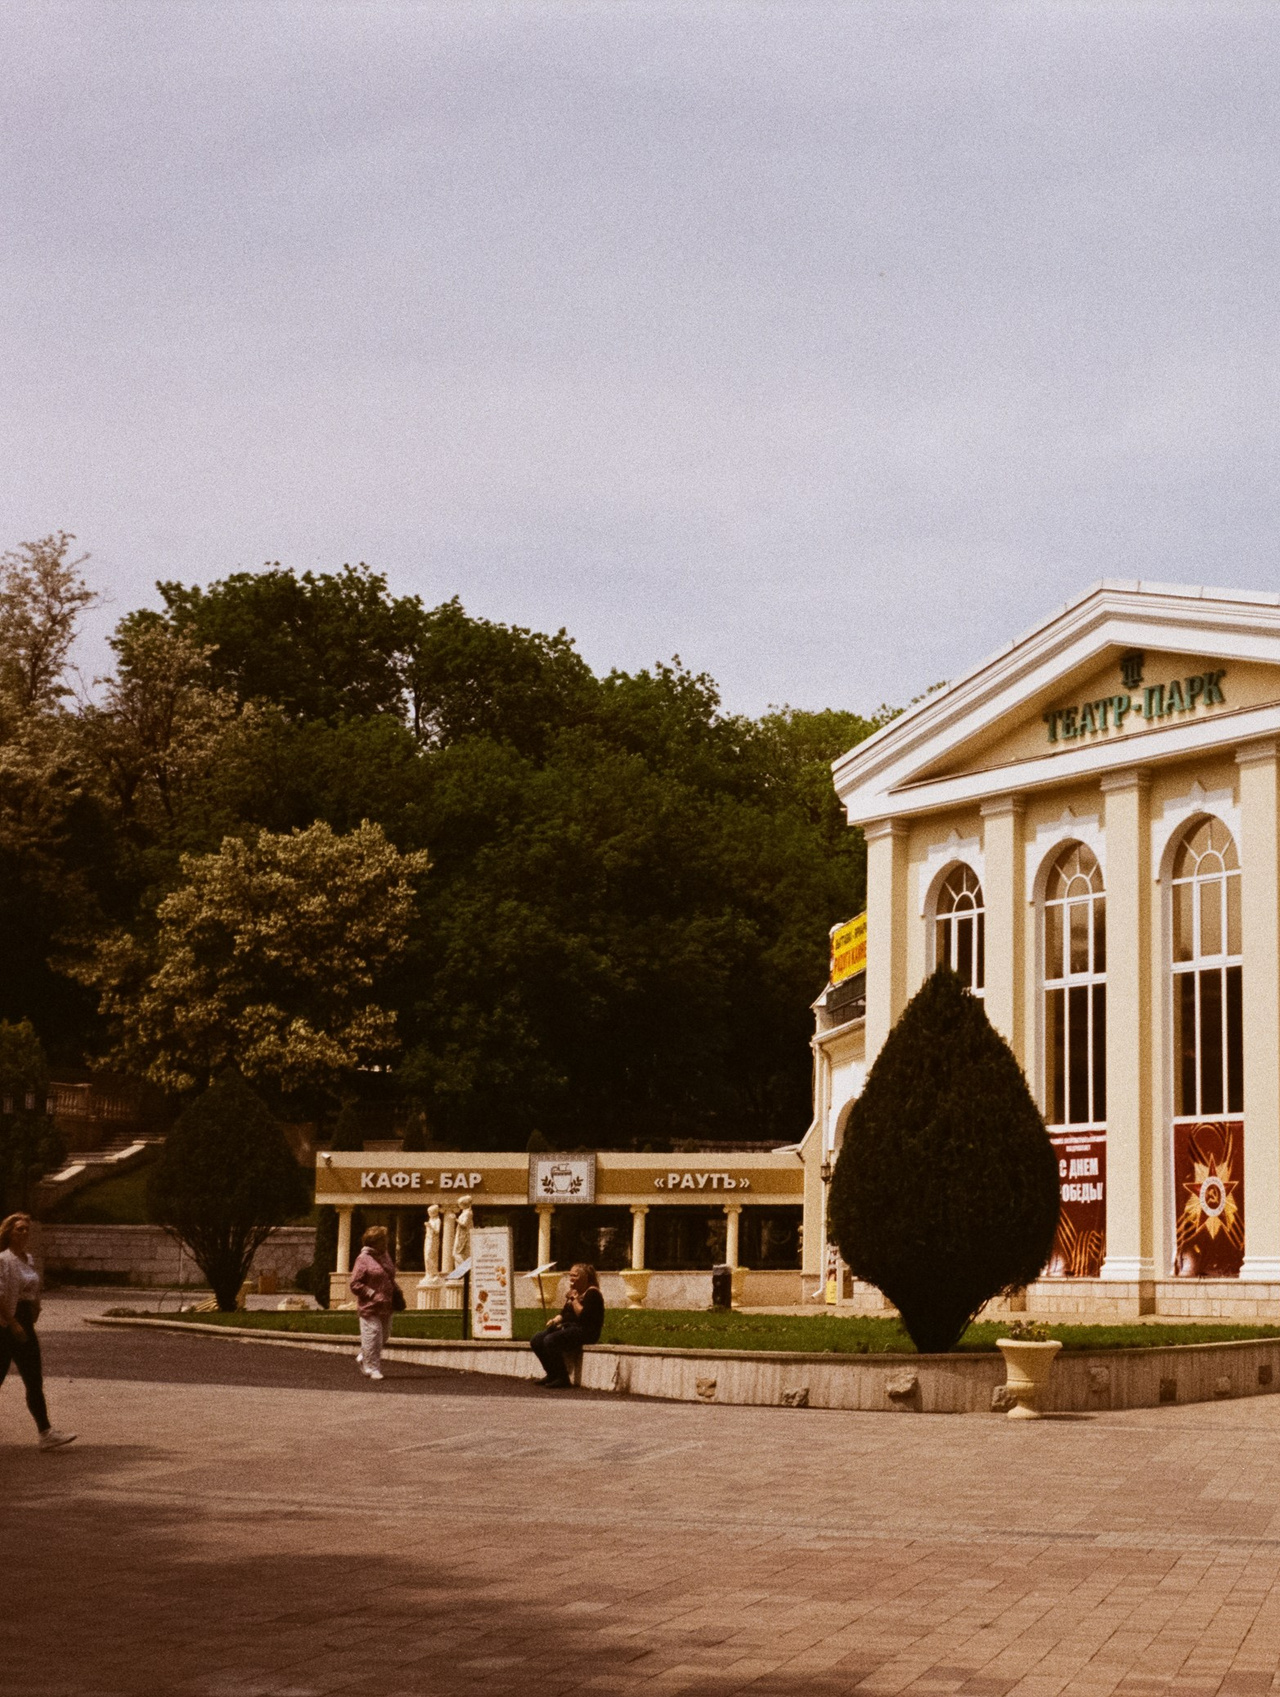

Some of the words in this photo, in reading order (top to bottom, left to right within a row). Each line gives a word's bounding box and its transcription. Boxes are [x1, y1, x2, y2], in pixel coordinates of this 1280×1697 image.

[1043, 669, 1226, 742] ТЕАТР-ПАРК
[1059, 1159, 1067, 1177] С
[1069, 1158, 1099, 1179] ДНЕМ
[361, 1172, 420, 1188] КАФЕ
[440, 1173, 481, 1188] БАР
[654, 1173, 750, 1189] «РАУТЪ»
[1060, 1182, 1103, 1204] ОБЕДЫ!
